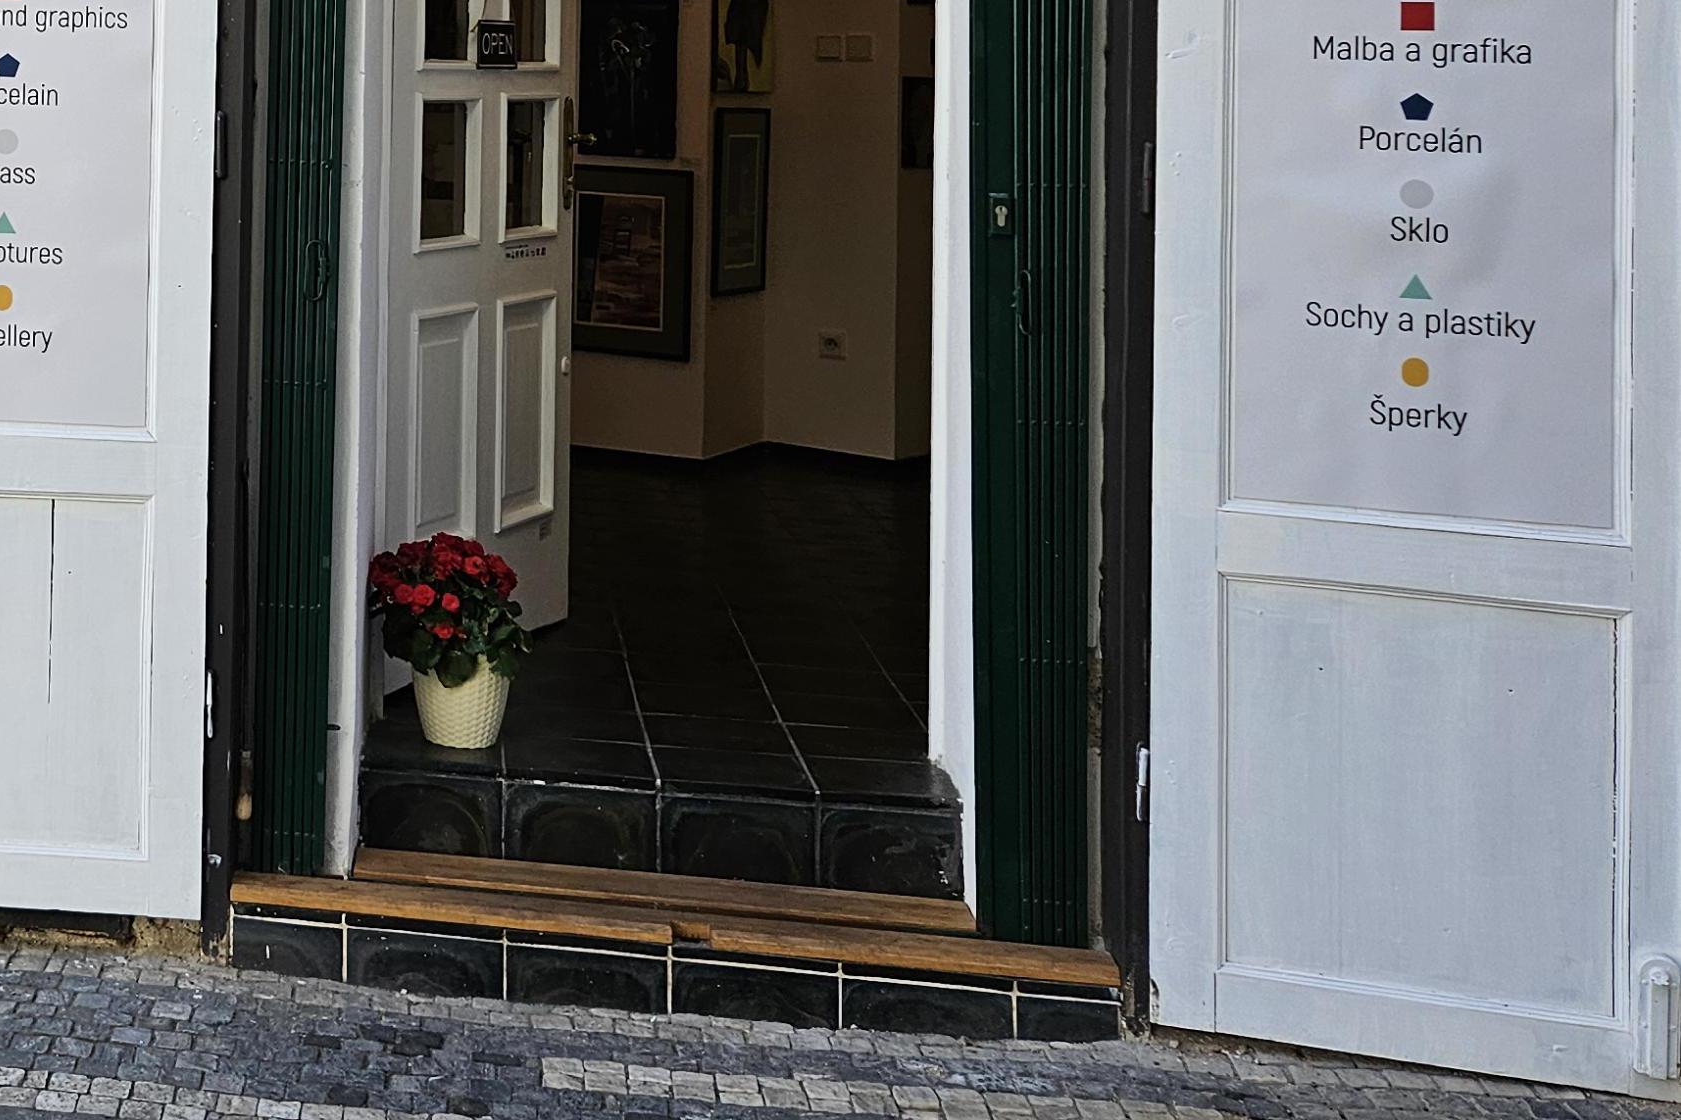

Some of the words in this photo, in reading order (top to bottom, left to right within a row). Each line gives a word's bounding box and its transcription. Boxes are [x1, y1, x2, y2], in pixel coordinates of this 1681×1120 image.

[36, 6, 127, 32] graphics
[482, 32, 514, 56] OPEN
[1314, 36, 1394, 61] Malba
[1406, 43, 1420, 61] a
[1433, 38, 1531, 68] grafika
[1360, 126, 1481, 153] Porcelán
[1391, 217, 1448, 243] Sklo
[1306, 302, 1388, 335] Sochy
[1399, 313, 1413, 331] a
[1426, 309, 1535, 344] plastiky
[1370, 394, 1467, 436] Šperky
